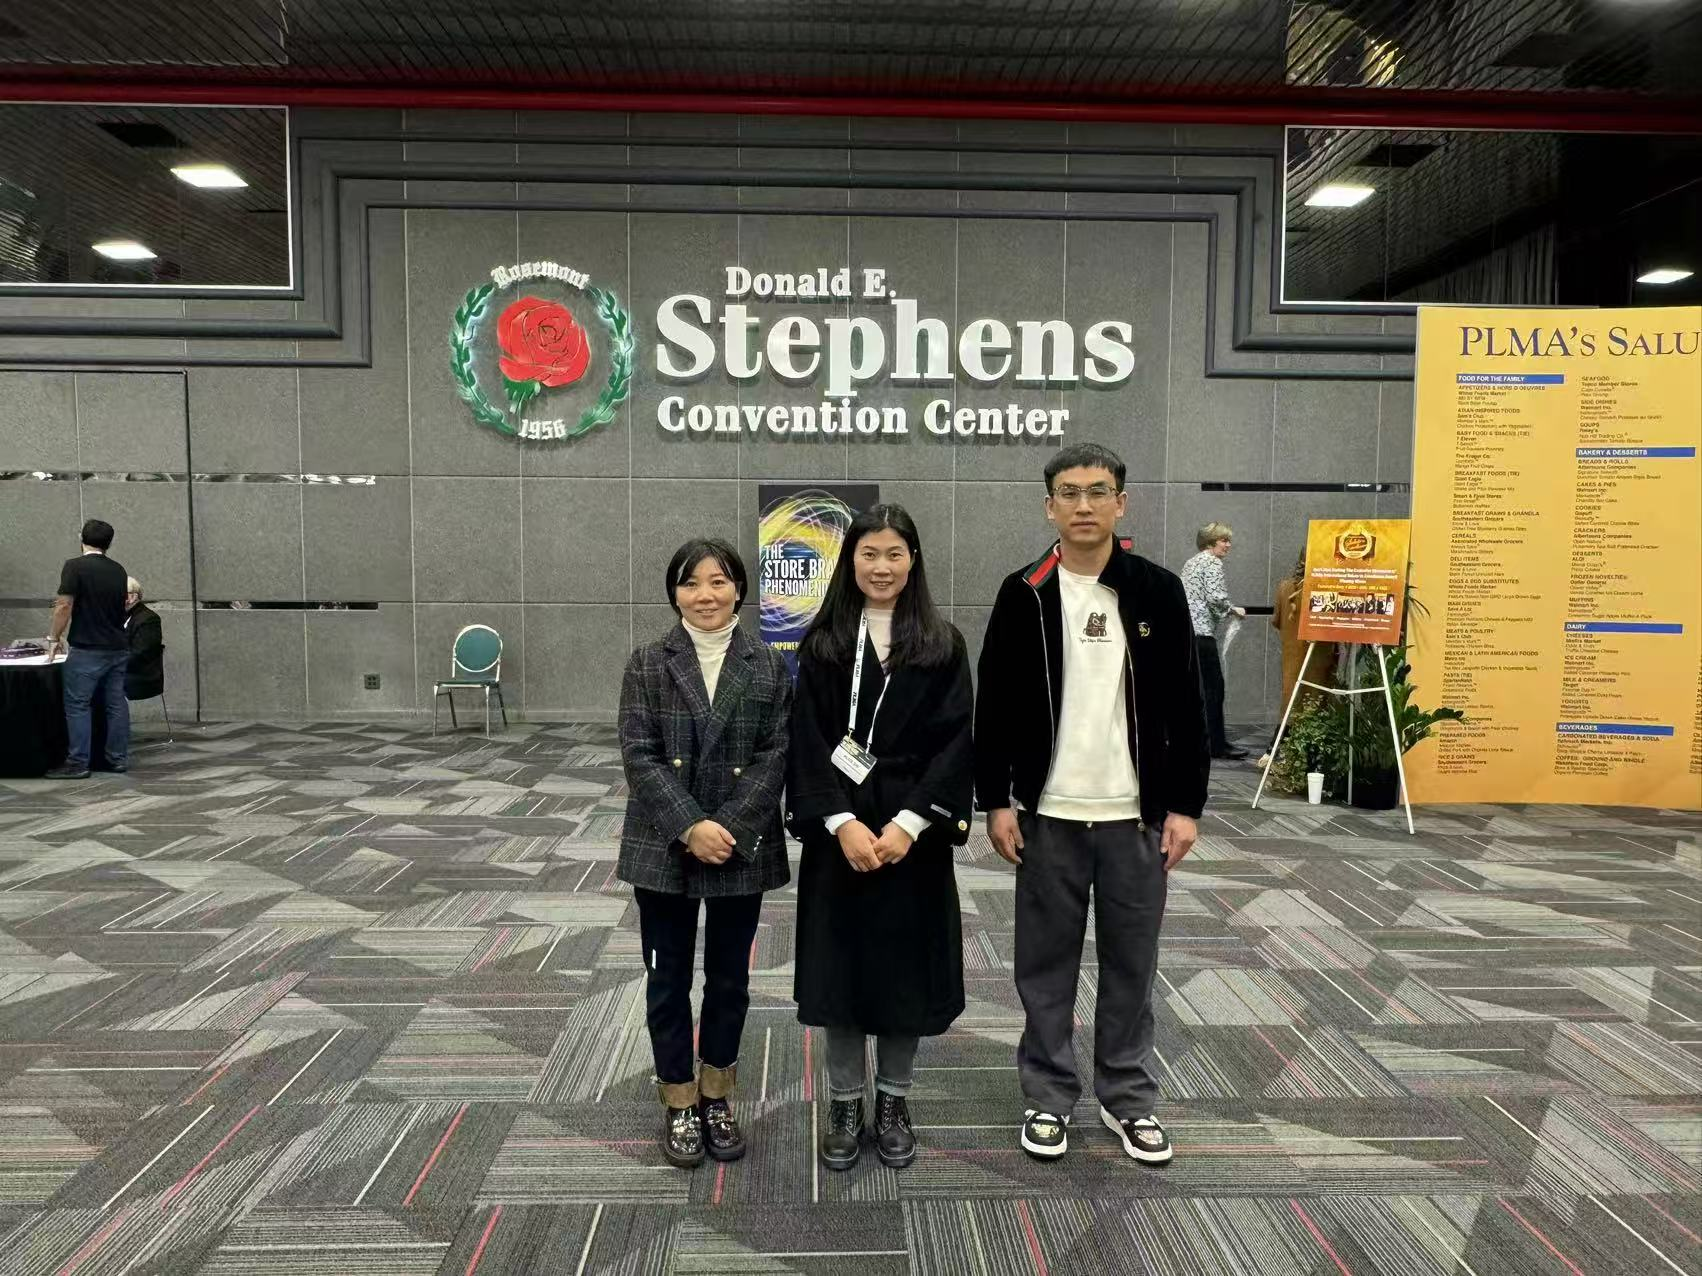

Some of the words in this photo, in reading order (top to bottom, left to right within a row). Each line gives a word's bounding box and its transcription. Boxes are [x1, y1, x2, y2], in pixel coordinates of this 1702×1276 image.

[491, 261, 590, 289] Rosemont
[725, 267, 851, 297] Donald
[863, 269, 897, 297] E.
[656, 294, 1135, 396] Stephens
[518, 418, 567, 440] 1956
[657, 396, 908, 435] Convention
[923, 399, 1070, 435] Center
[764, 544, 784, 560] THE
[764, 559, 805, 578] STORE
[809, 559, 838, 579] BRA
